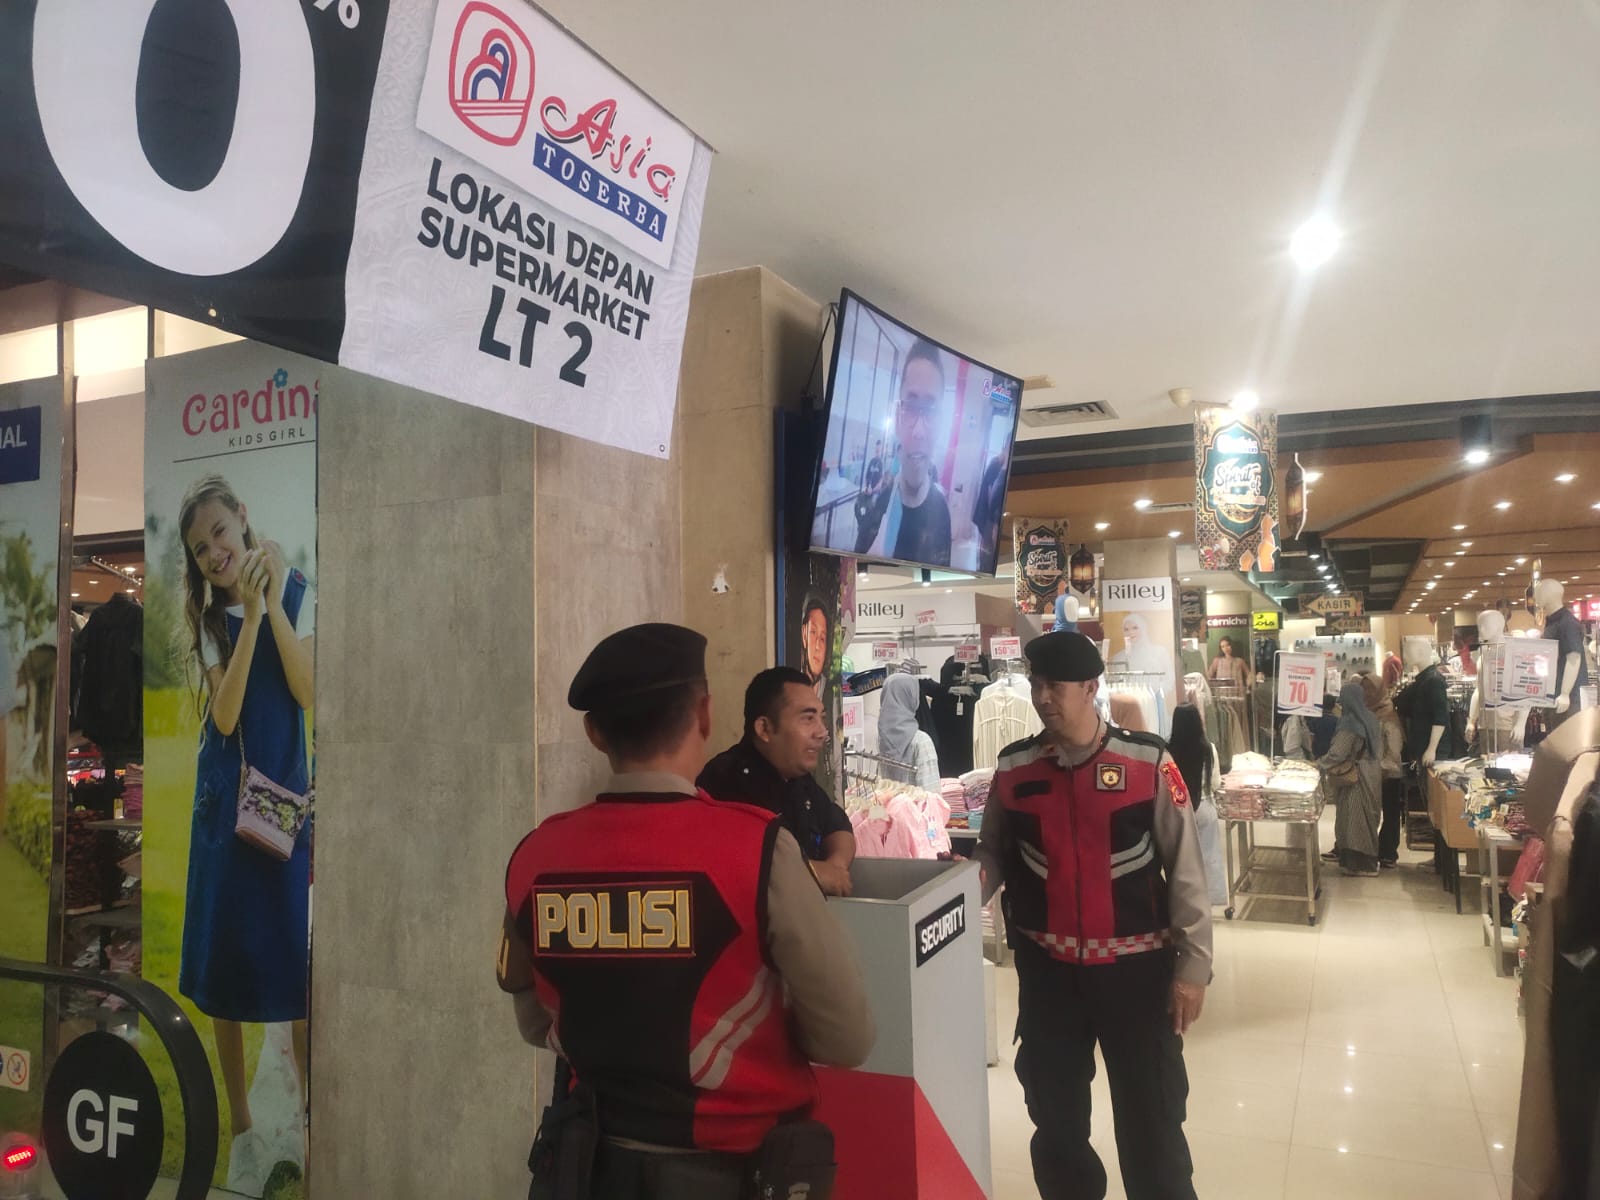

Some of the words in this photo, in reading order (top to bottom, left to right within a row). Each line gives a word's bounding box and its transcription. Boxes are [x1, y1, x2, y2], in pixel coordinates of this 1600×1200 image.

[540, 96, 675, 201] Asia
[542, 144, 661, 236] TOSERBA
[427, 156, 556, 256] LOKASI
[566, 230, 654, 305] DEPAN
[417, 206, 650, 340] SUPERMARKET
[478, 284, 551, 368] LT
[559, 320, 593, 388] 2
[228, 433, 263, 447] KIDS
[269, 427, 305, 441] GIRL
[858, 603, 904, 620] Rilley
[1108, 583, 1165, 603] Rilley
[1289, 681, 1308, 704] 70
[536, 889, 690, 949] POLISI
[921, 904, 964, 954] SECURITY
[67, 1089, 138, 1158] GF
